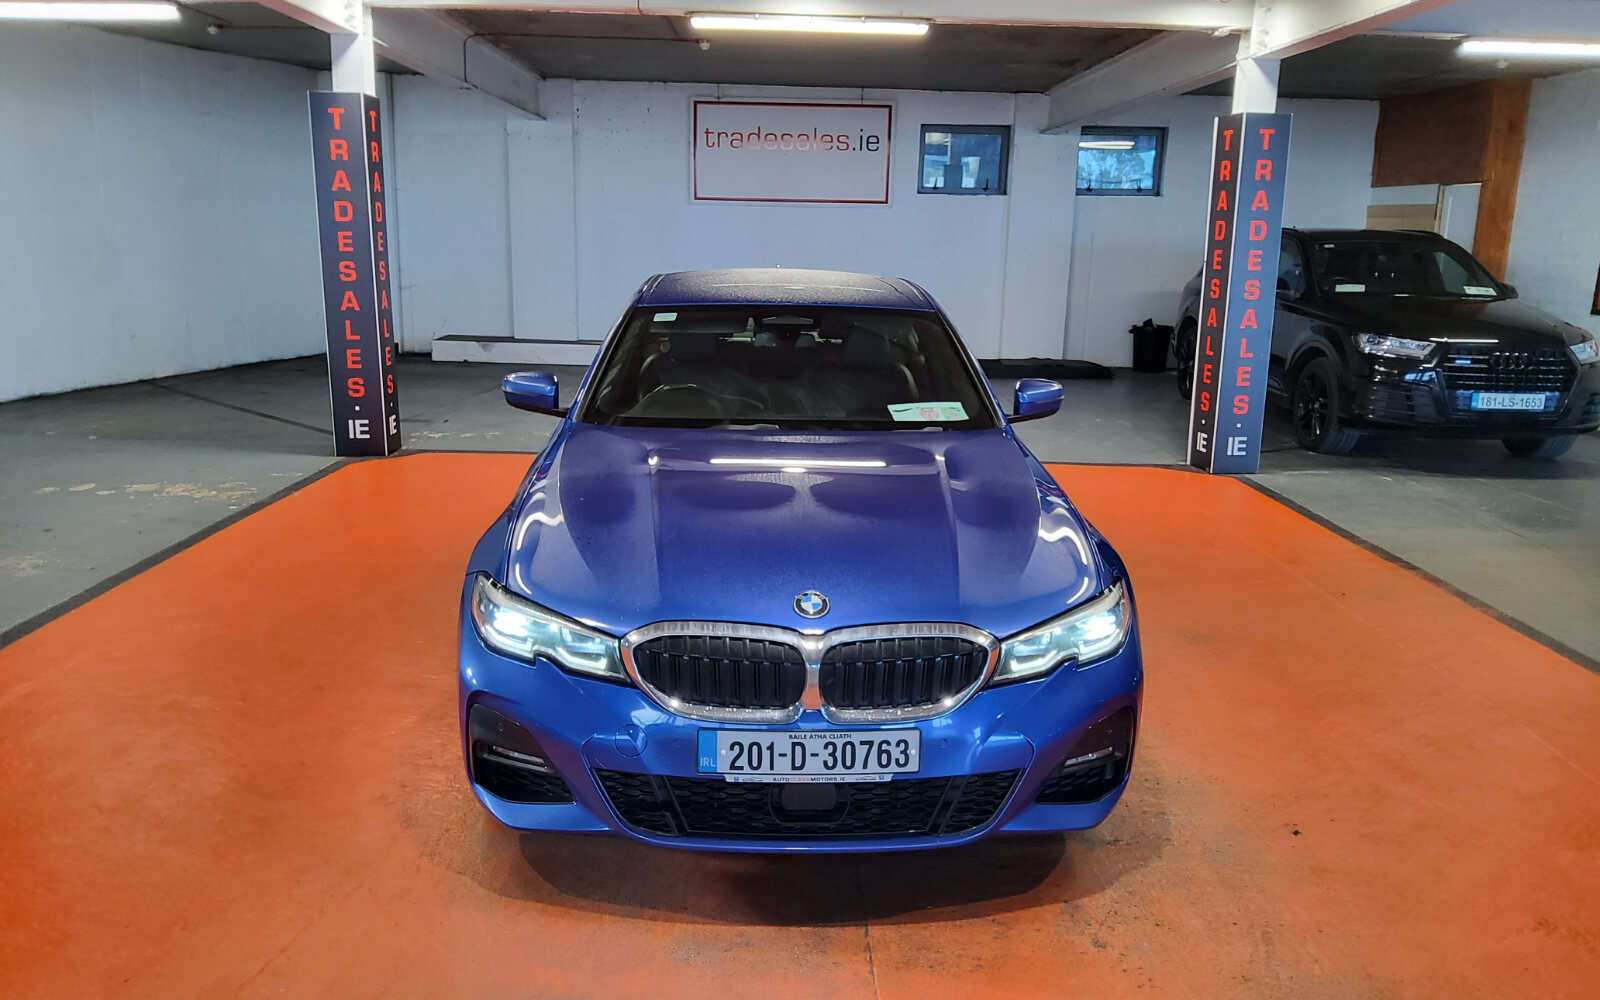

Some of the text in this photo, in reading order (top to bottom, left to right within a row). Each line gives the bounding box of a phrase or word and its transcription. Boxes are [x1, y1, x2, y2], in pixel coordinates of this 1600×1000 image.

[703, 126, 880, 151] tradesales.ie
[1480, 396, 1543, 408] 181-LS-1653
[700, 757, 716, 767] IRL
[729, 739, 910, 771] 201-D-30763
